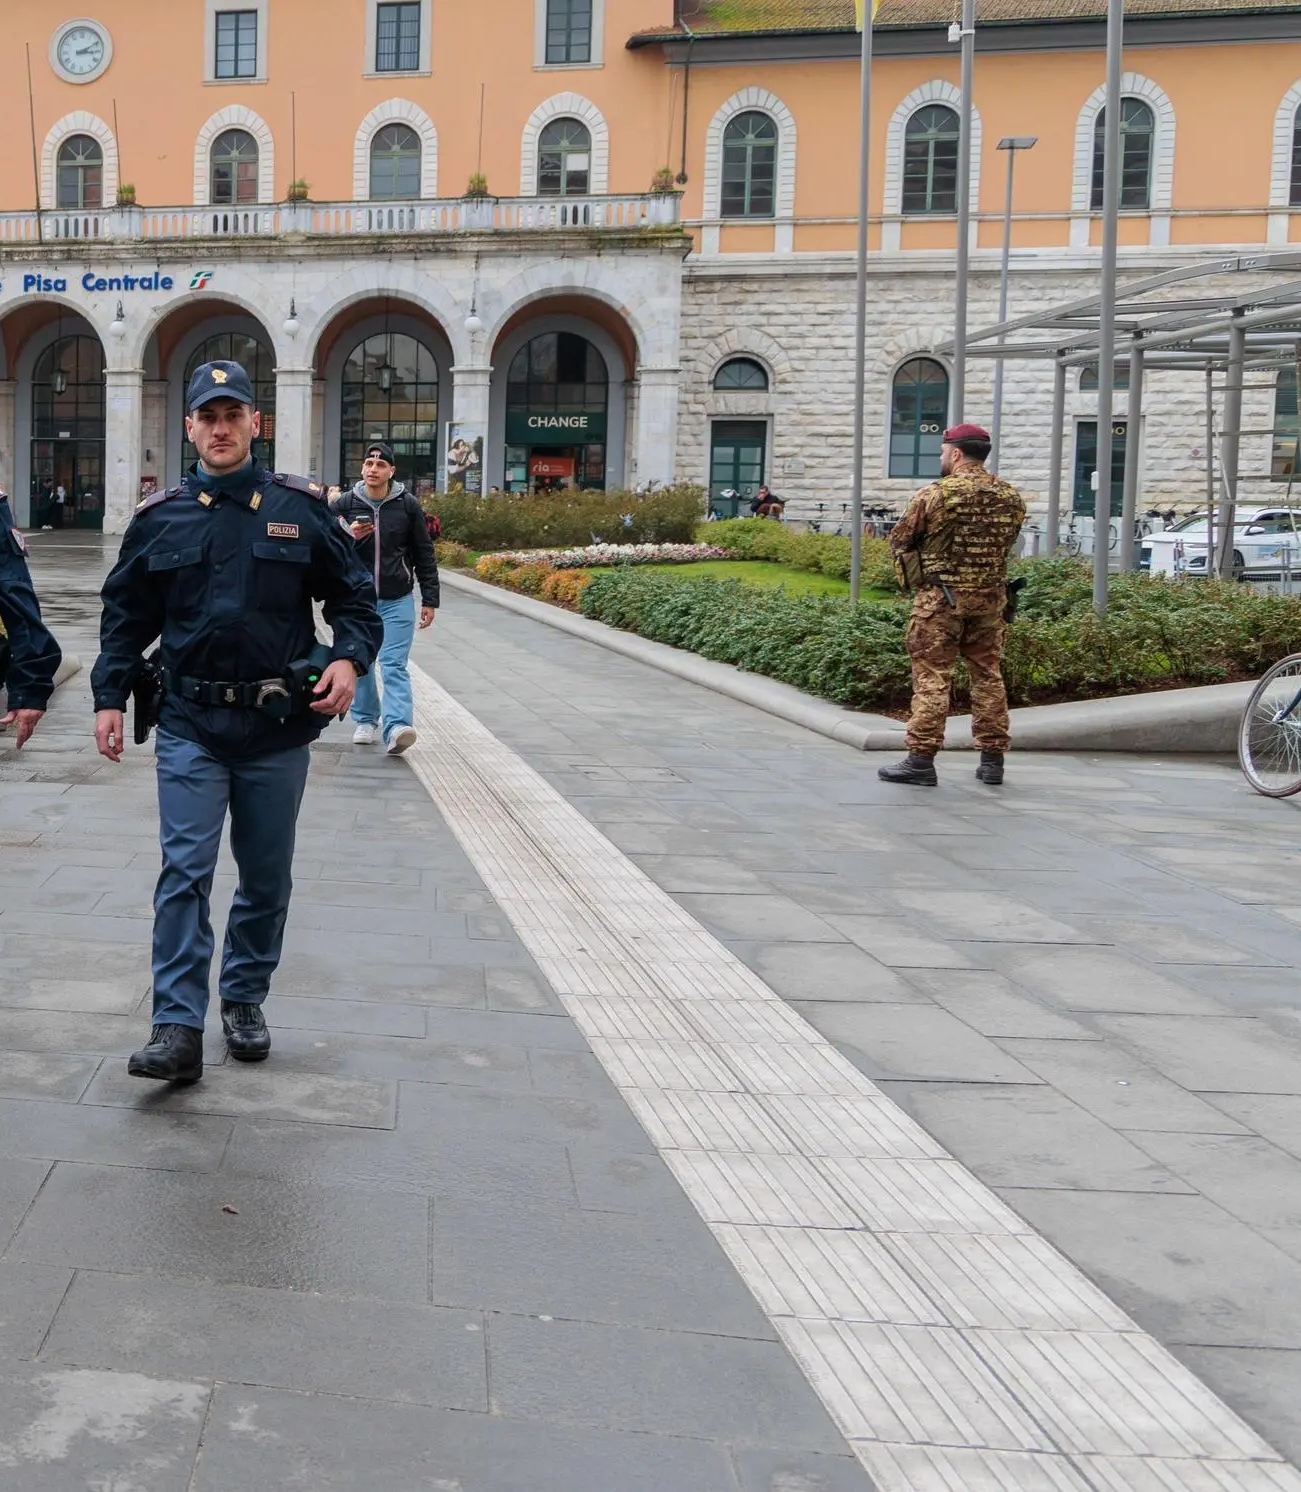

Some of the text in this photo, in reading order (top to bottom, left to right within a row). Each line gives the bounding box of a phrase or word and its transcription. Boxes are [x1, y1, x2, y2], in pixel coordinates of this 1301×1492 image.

[23, 274, 67, 292] Pisa
[81, 272, 173, 291] Centrale
[527, 416, 588, 428] CHANGE
[269, 525, 296, 535] POLIZIA
